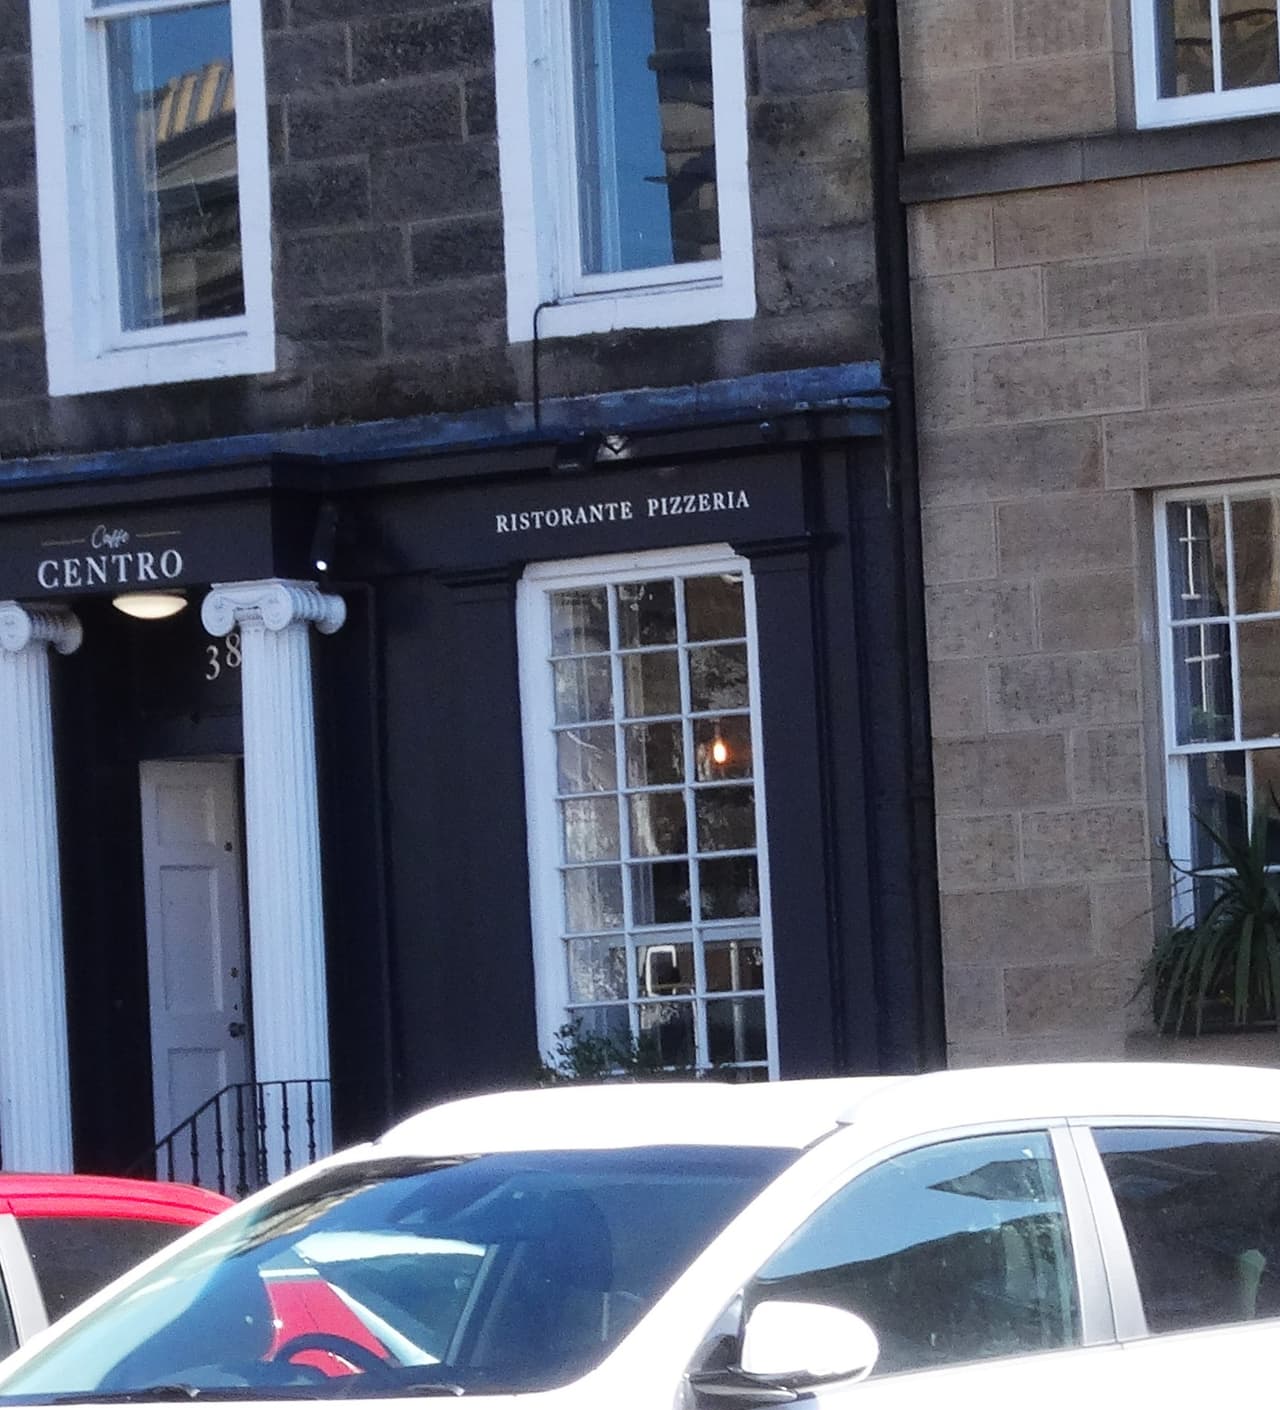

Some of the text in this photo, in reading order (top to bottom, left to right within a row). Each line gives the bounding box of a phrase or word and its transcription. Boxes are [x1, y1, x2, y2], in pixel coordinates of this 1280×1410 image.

[495, 490, 750, 533] RISTORANTE PIZZERIA
[37, 549, 183, 589] CENTRO
[206, 633, 242, 680] 38
